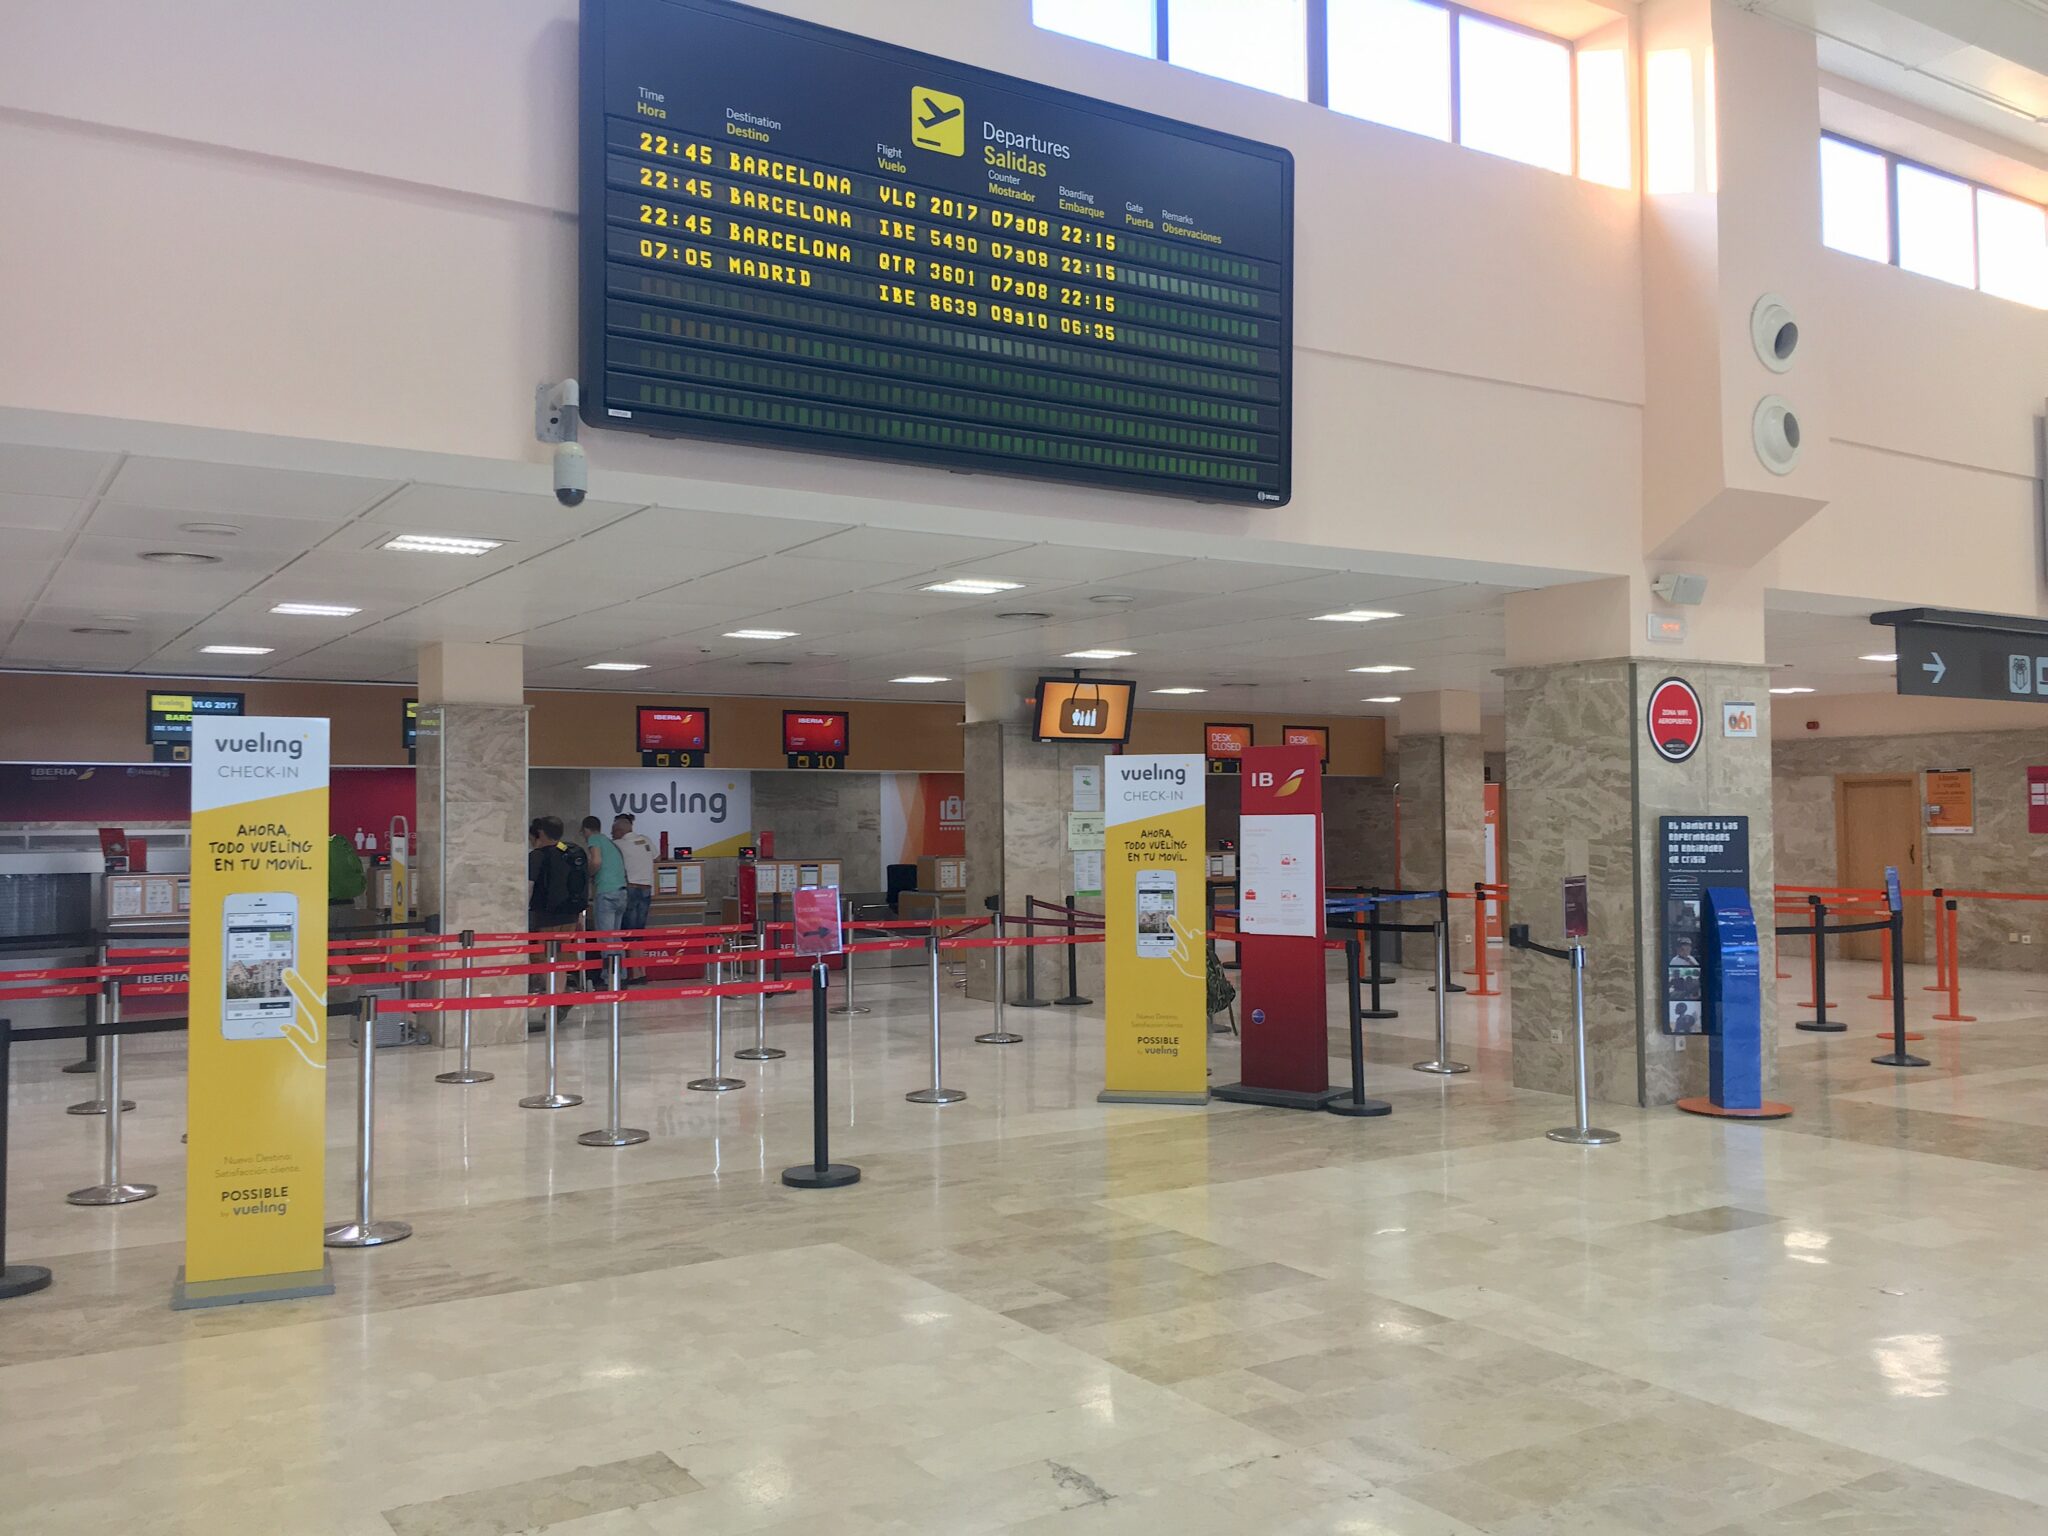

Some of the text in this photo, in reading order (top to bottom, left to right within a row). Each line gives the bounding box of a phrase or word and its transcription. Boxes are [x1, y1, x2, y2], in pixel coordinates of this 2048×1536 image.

[638, 86, 665, 103] Time
[637, 101, 666, 120] Hora
[726, 107, 782, 131] Destination
[727, 122, 770, 143] Destino
[983, 121, 1070, 160] Departures
[877, 143, 903, 160] Flight
[878, 157, 907, 174] Vuelo
[983, 146, 1047, 178] Salidas
[988, 169, 1020, 186] Counter
[640, 133, 1116, 252] 22:45 BARCELONA VLG 2017 07a08 22:15
[988, 183, 1036, 203] Mostrador
[1059, 186, 1094, 204] Boarding
[1059, 199, 1105, 219] Embarque
[1125, 201, 1144, 214] Gate
[640, 168, 1116, 282] 22:45 BARCELONA IBE 5490 07a08 22:15
[1125, 214, 1154, 230] Puerta
[1162, 209, 1193, 225] Remarks
[1162, 222, 1222, 245] Observaciones
[640, 205, 1116, 313] 22:45 BARCELONA QTR 3601 07a08 22:15
[640, 240, 1116, 342] 07:05 MADRID IBE 8639 09a10 06:35
[192, 701, 213, 709] VLG
[798, 717, 824, 725] IBERIA
[215, 731, 303, 760] vueling
[1211, 733, 1232, 742] DESK
[1289, 735, 1309, 744] DESK
[1211, 742, 1242, 752] CLOSED
[680, 752, 691, 768] 9
[817, 755, 836, 769] 10
[218, 765, 299, 779] CHECK-IN
[1121, 762, 1186, 785] vueling
[1251, 772, 1274, 787] IB
[609, 781, 728, 824] vueling
[1123, 790, 1184, 802] CHECK-IN
[236, 823, 291, 837] AHORA,
[209, 841, 245, 854] TODO
[1124, 841, 1146, 850] TODO
[214, 858, 235, 871] EN
[240, 858, 260, 871] TU
[1127, 852, 1140, 862] EN
[1143, 853, 1155, 862] TU
[137, 974, 190, 984] IBERIA
[1137, 1036, 1180, 1045] POSSIBLE
[1144, 1045, 1178, 1057] vueling
[221, 1186, 289, 1202] POSSIBLE
[233, 1200, 287, 1216] vueling
